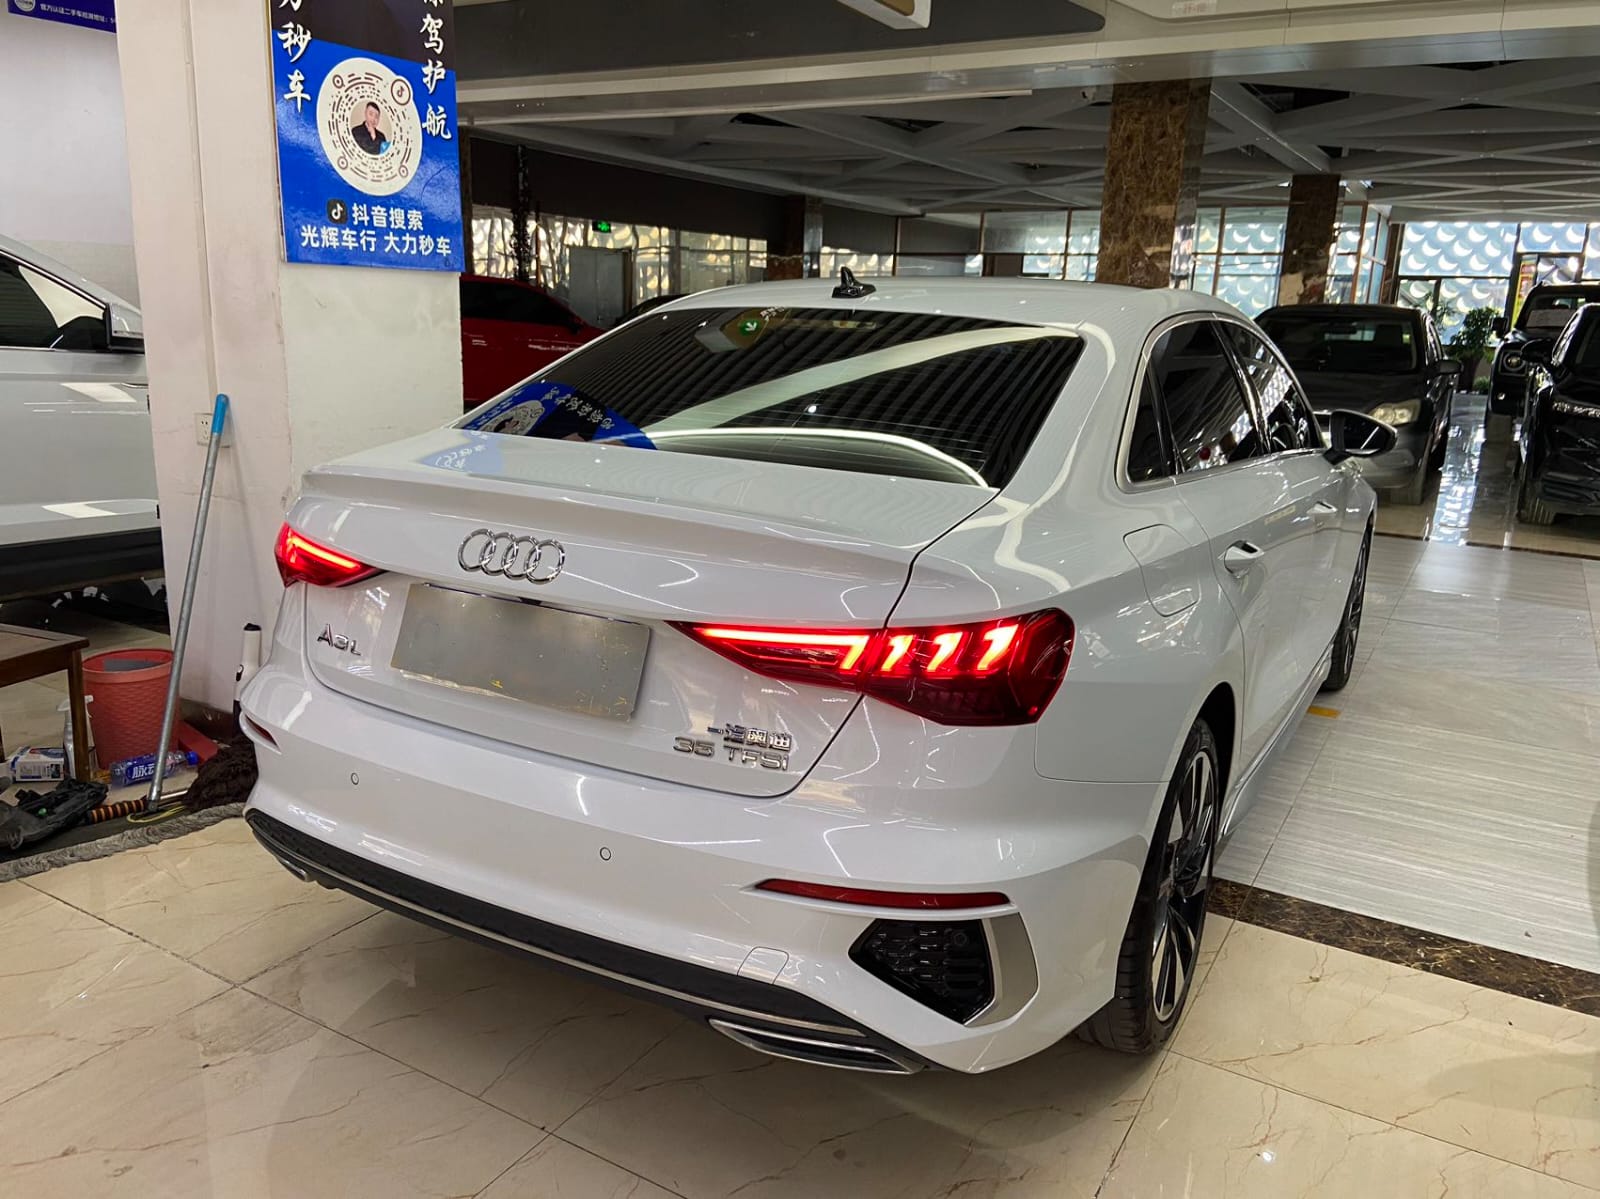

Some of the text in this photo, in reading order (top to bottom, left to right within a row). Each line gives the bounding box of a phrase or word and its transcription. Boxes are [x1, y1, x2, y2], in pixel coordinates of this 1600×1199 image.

[420, 0, 452, 138] 驾护航
[351, 202, 423, 231] 抖音搜索
[300, 225, 452, 257] 光辉车行 大力秒车
[316, 623, 362, 656] A3L
[672, 736, 716, 758] 35
[707, 722, 793, 752] 一汽奥迪
